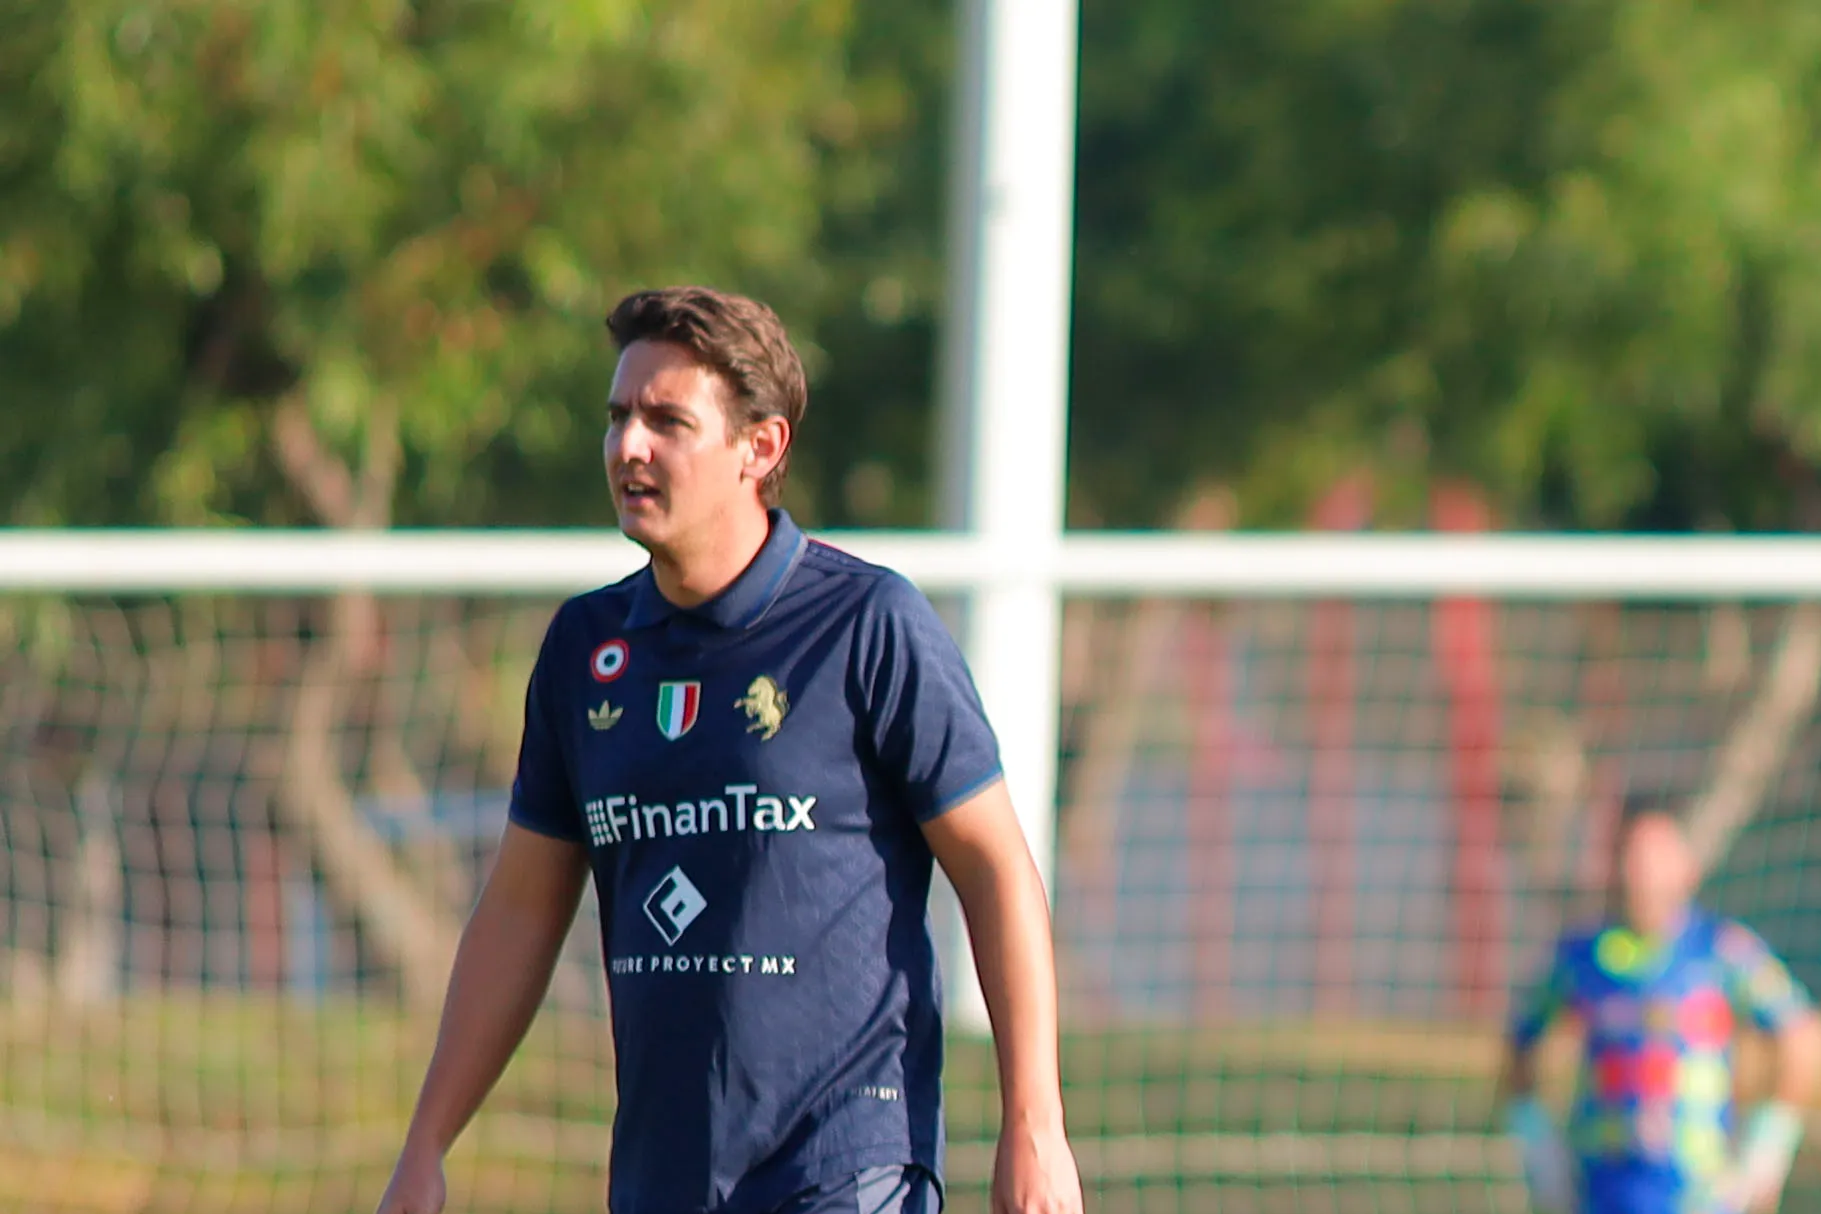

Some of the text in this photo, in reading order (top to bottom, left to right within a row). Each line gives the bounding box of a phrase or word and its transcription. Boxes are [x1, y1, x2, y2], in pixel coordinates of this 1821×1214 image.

[606, 784, 817, 842] FinanTax
[651, 955, 753, 974] PROYECT
[761, 956, 796, 975] MX
